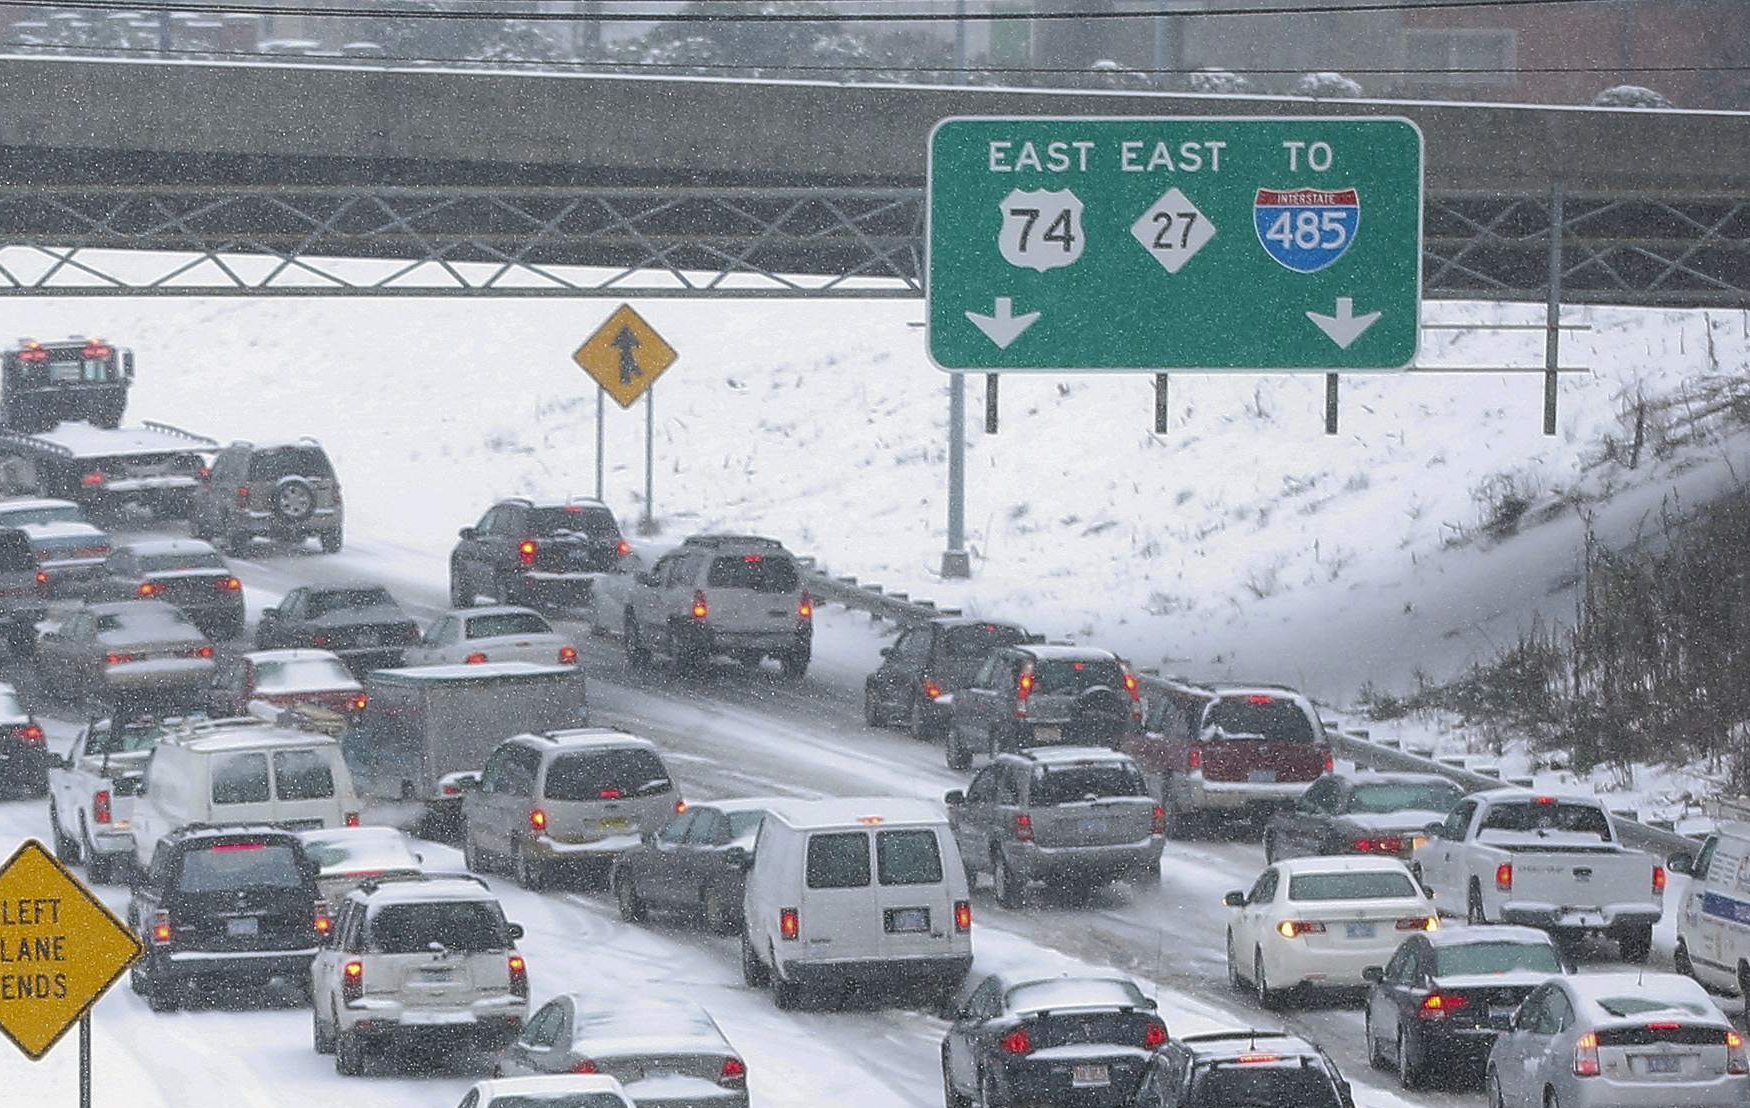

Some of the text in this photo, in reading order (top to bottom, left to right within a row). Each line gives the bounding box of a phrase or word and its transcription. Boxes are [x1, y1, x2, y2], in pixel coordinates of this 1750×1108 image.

[989, 141, 1334, 173] EAST EAST TO
[1277, 192, 1337, 205] INTERSTATE
[1009, 208, 1076, 253] 74
[1151, 212, 1198, 250] 27
[1266, 211, 1348, 250] 485
[1, 898, 62, 925] LEFT
[0, 936, 67, 963] LANE
[1, 973, 68, 1000] ENDS
